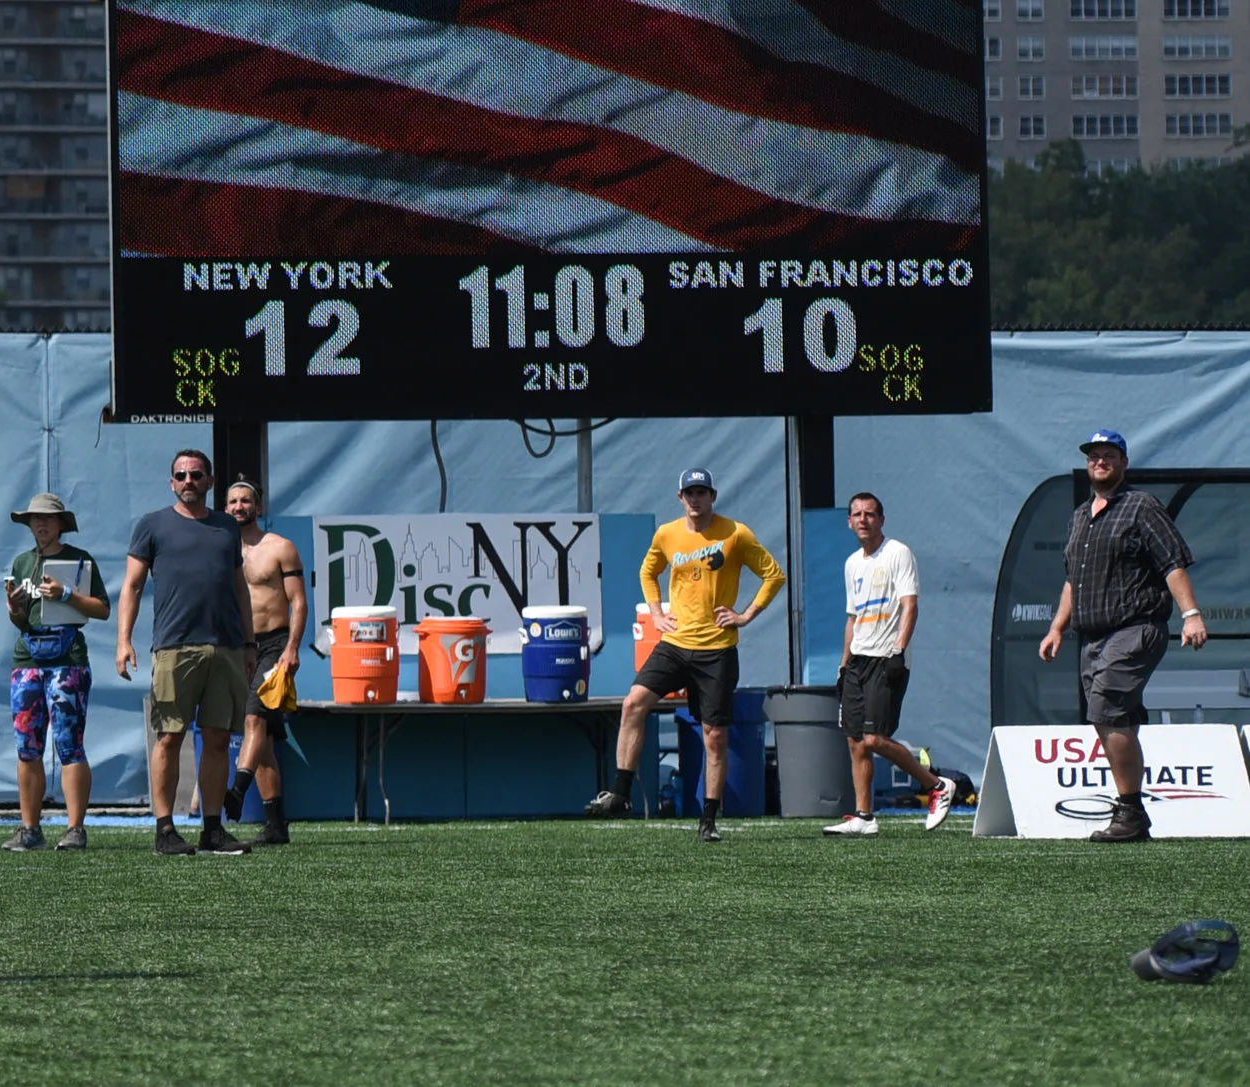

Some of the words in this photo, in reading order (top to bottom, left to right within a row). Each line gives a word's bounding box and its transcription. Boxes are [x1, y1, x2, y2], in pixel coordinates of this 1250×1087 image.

[183, 262, 272, 291] NEW
[281, 261, 393, 290] YORK
[668, 260, 744, 289] SAN
[760, 258, 974, 289] FRANCISCO
[458, 264, 645, 349] 11:08
[245, 299, 361, 377] 12
[743, 297, 857, 373] 10
[172, 348, 240, 377] SOG
[860, 344, 924, 372] SOG
[523, 362, 589, 391] 2ND
[882, 374, 923, 402] CK
[175, 379, 217, 407] CK
[130, 413, 215, 424] DAKTRONICS
[454, 639, 474, 662] G
[1034, 737, 1108, 764] USA
